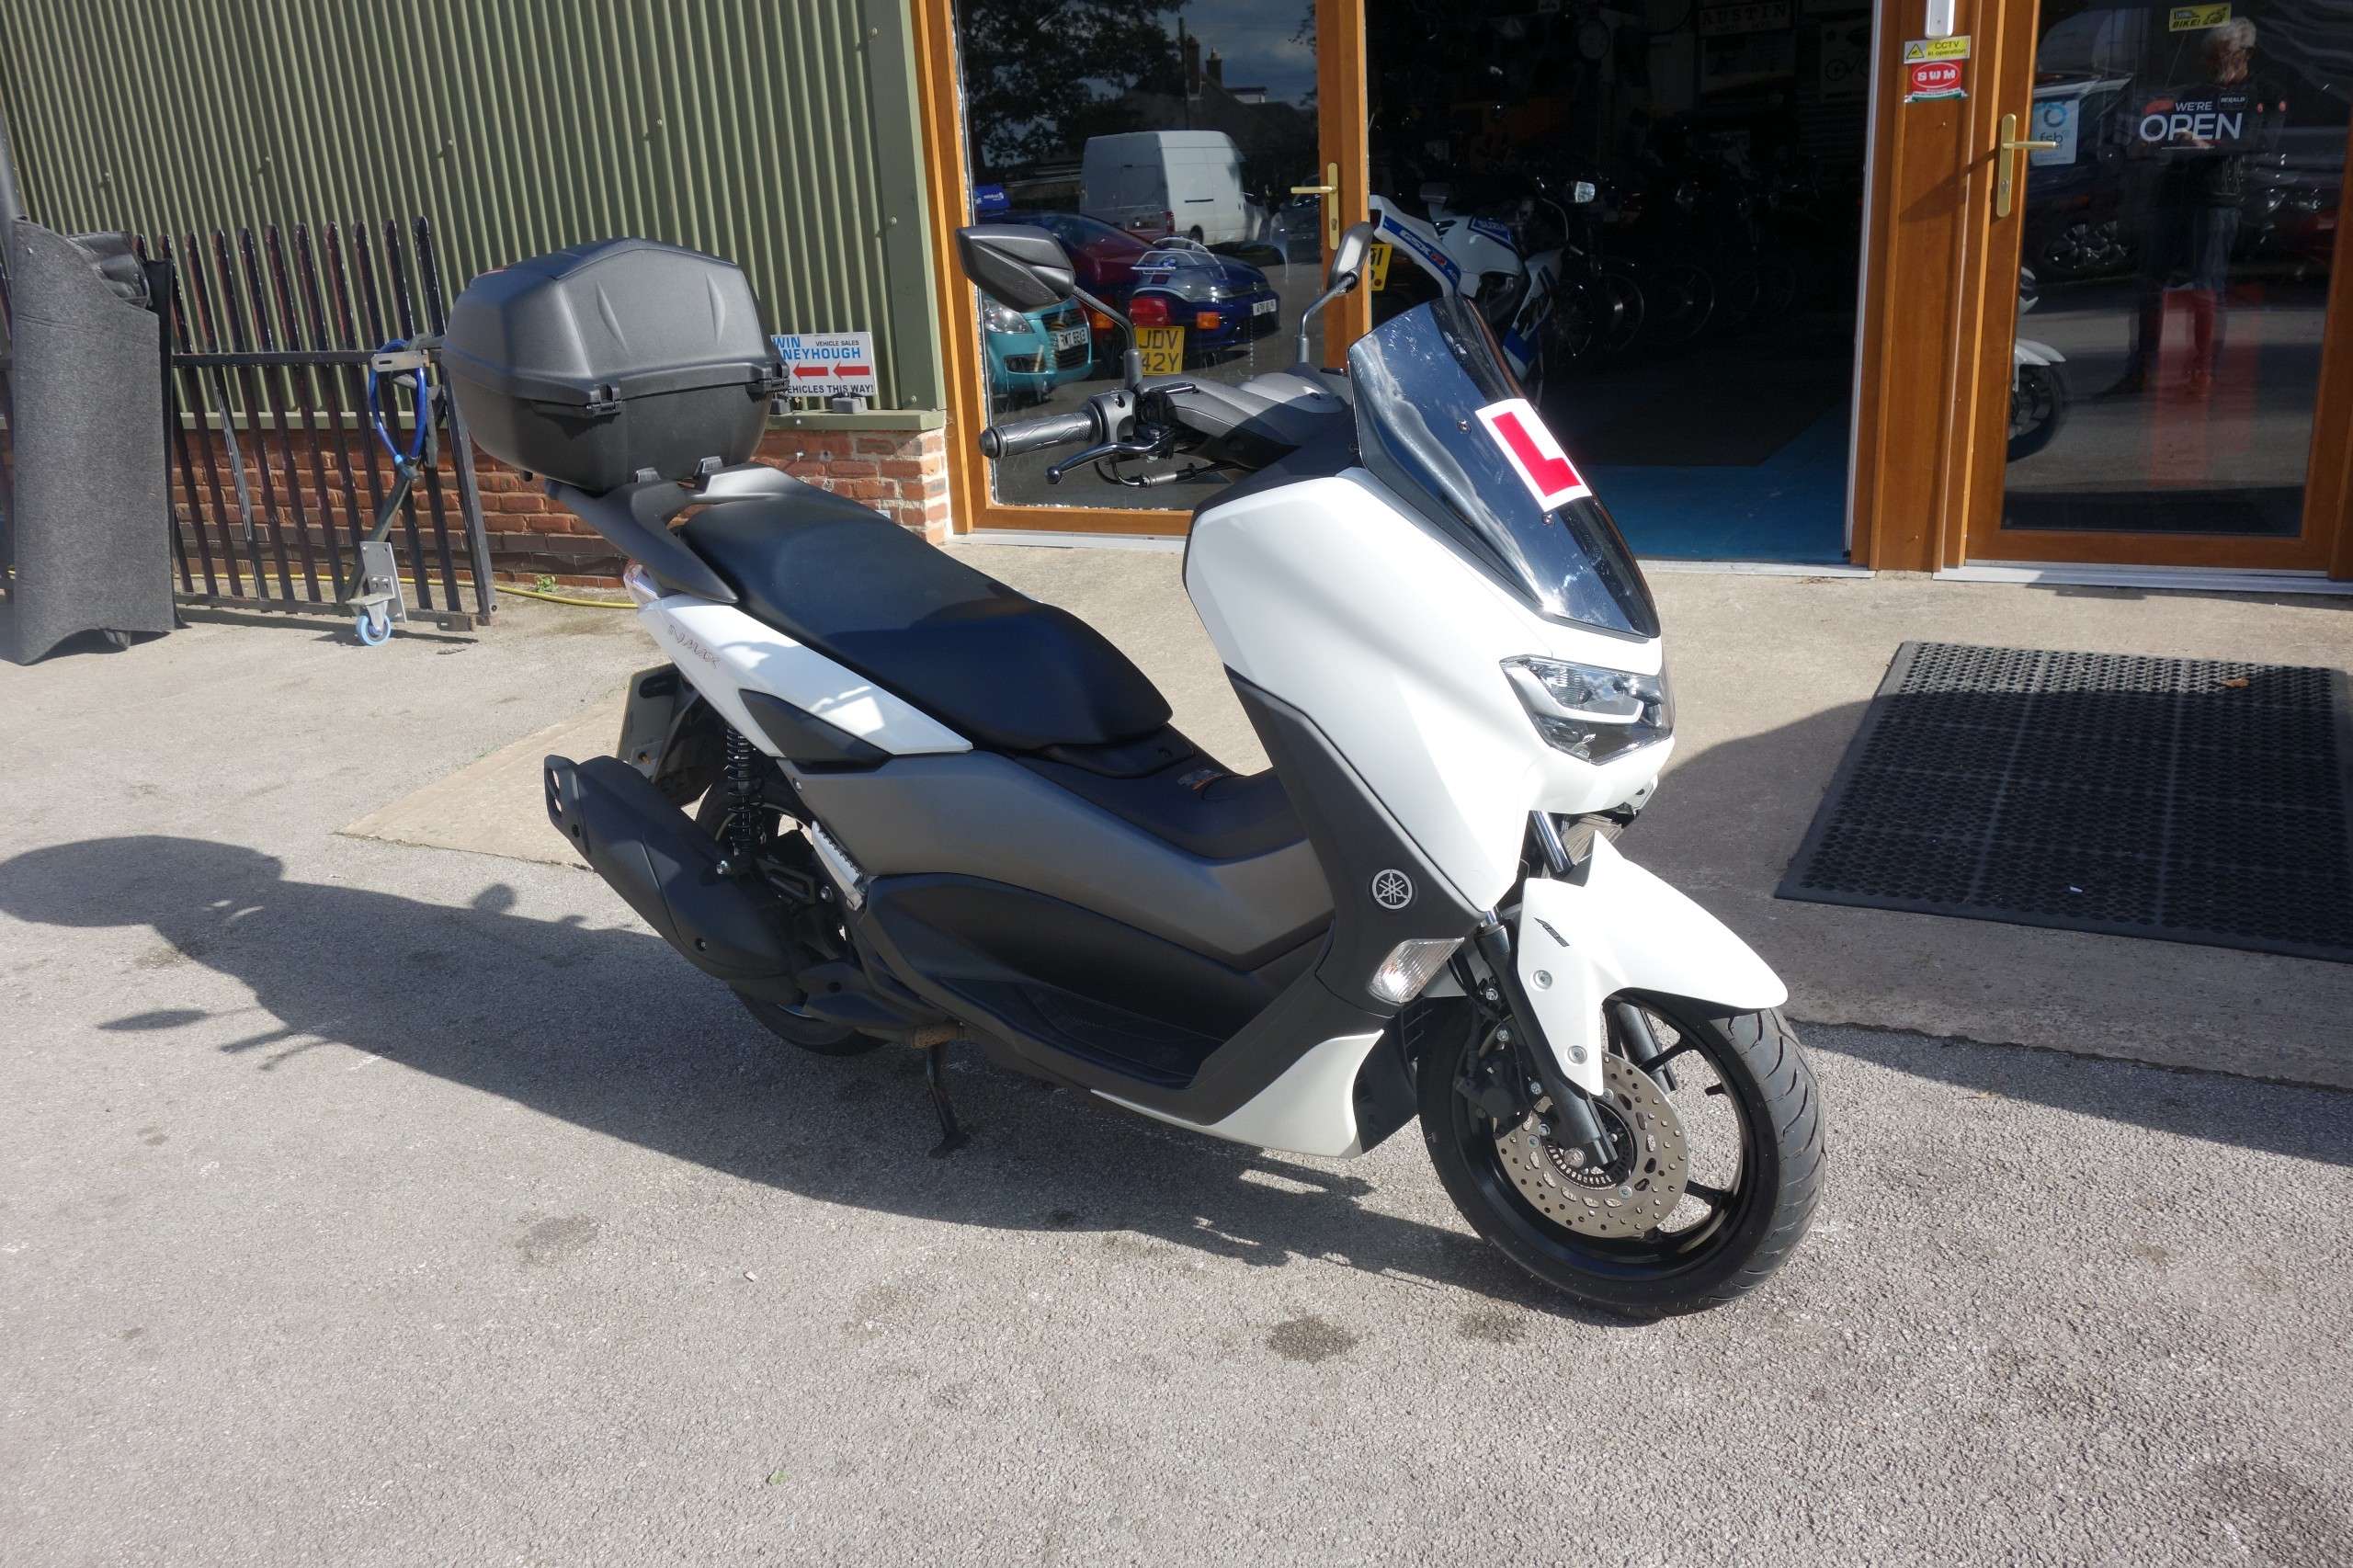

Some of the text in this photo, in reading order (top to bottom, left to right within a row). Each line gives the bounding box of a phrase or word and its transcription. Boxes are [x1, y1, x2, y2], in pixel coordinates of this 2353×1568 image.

[1935, 40, 1960, 49] CCTV
[1917, 69, 1956, 82] SWM
[2175, 101, 2212, 111] WE'RE
[2140, 112, 2243, 142] OPEN
[1138, 330, 1178, 349] JDV
[782, 347, 860, 360] NEYHOUGH
[1142, 352, 1178, 371] 42Y
[787, 383, 874, 393] EHICLES THIS WAY!
[1491, 411, 1581, 497] L
